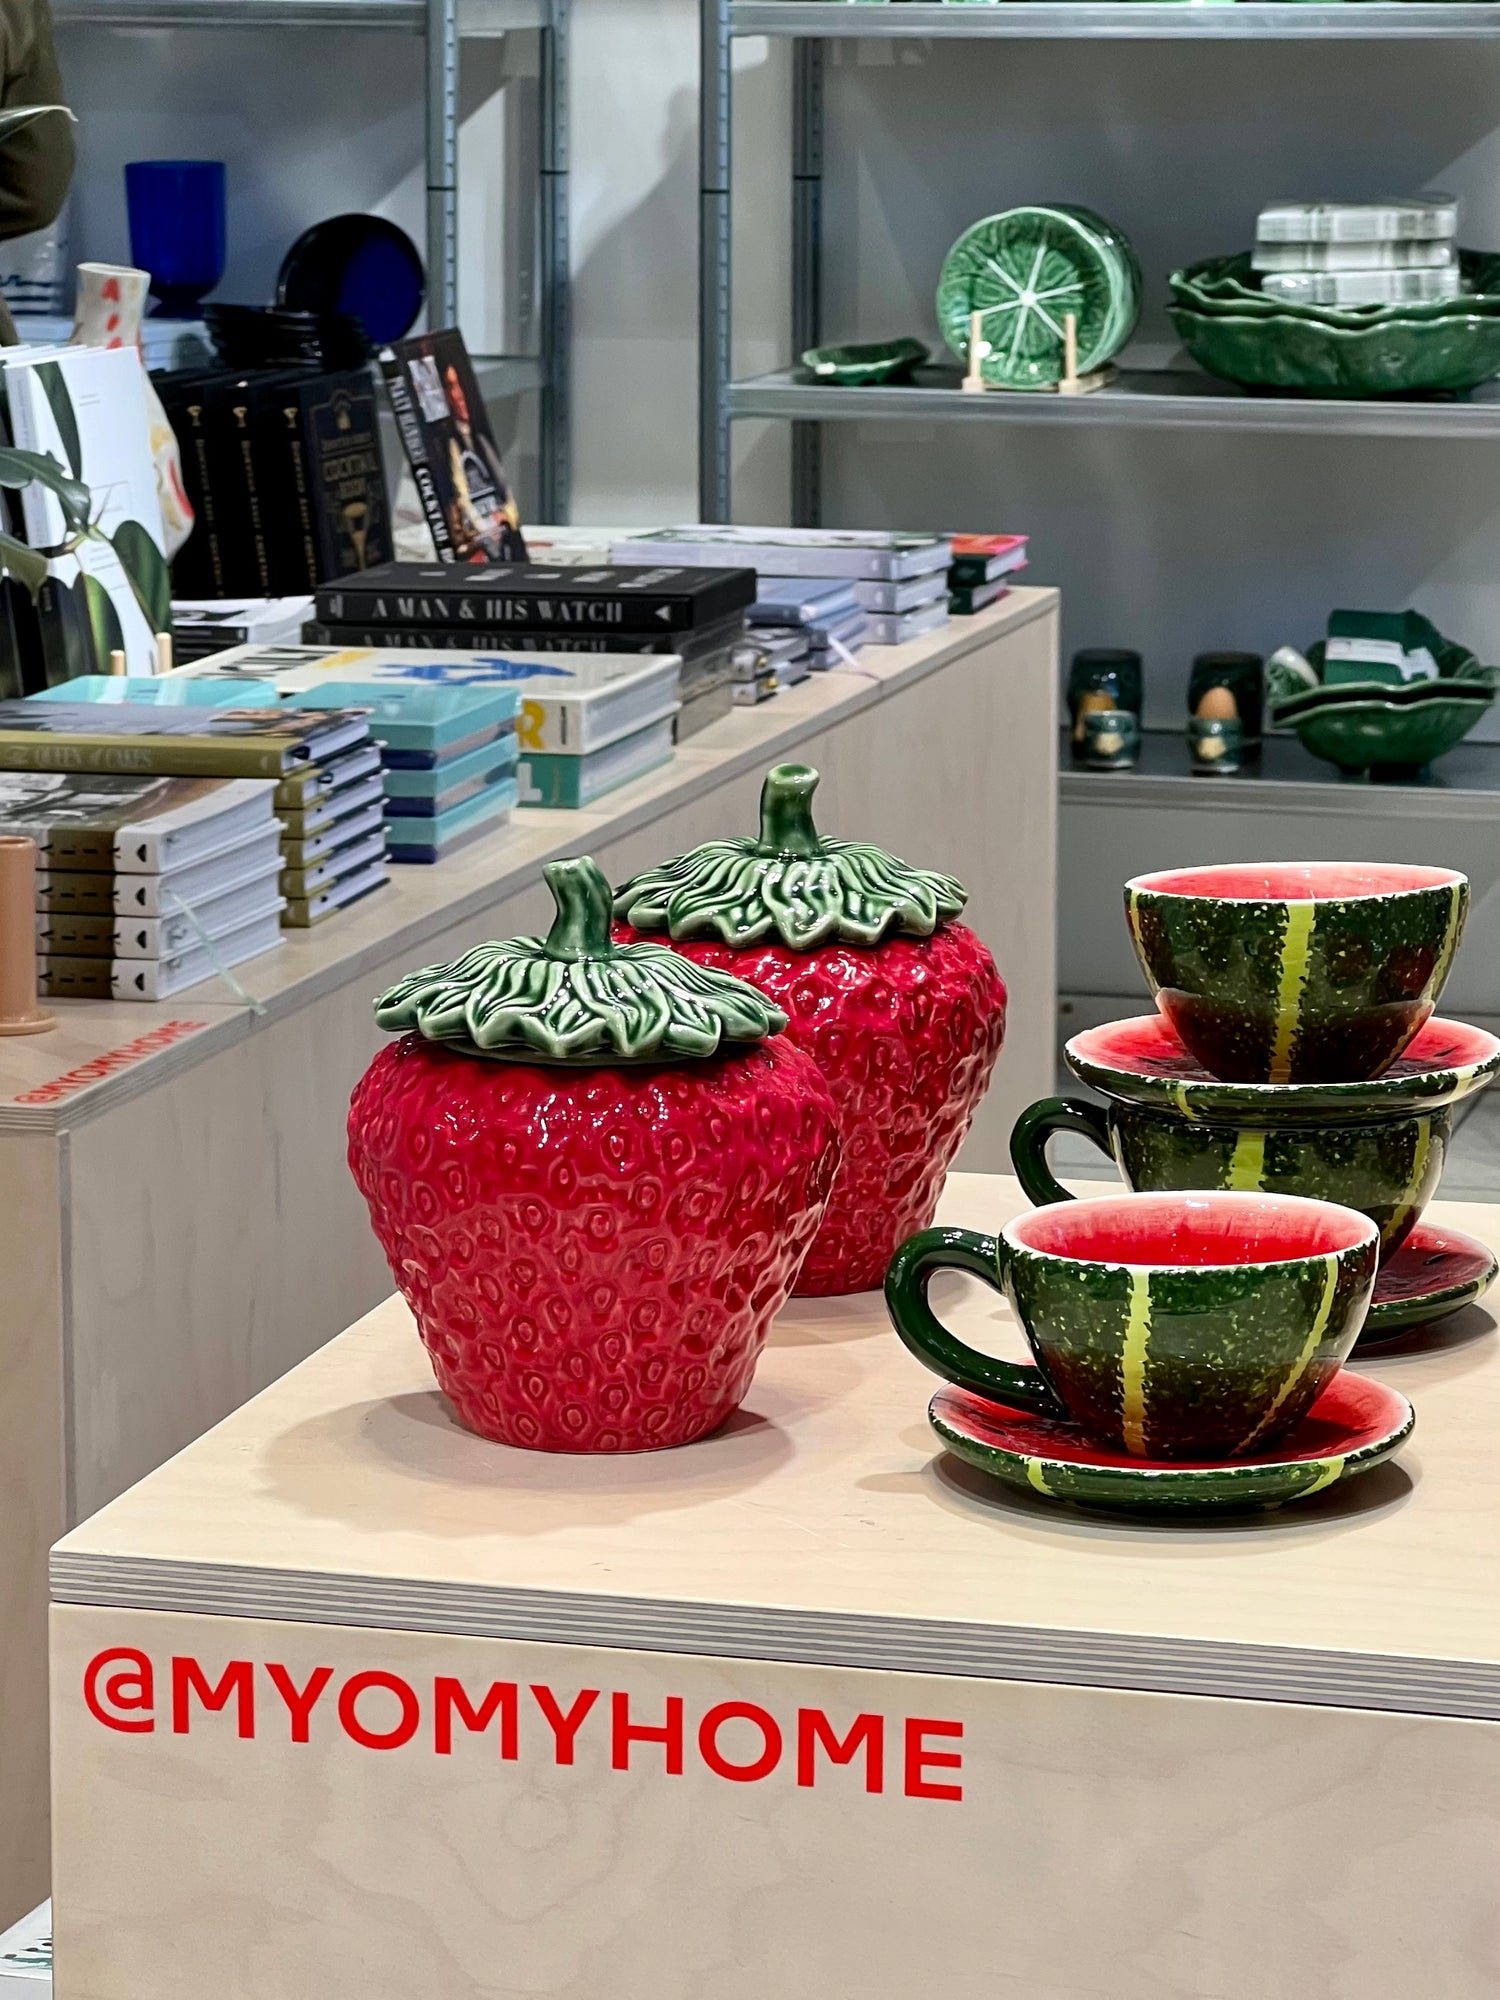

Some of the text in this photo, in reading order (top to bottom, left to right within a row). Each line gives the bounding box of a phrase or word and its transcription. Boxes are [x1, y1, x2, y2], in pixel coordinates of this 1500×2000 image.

[371, 598, 623, 622] A MAN & HIS WATCH
[84, 1647, 964, 1801] @MYOMYHOME
